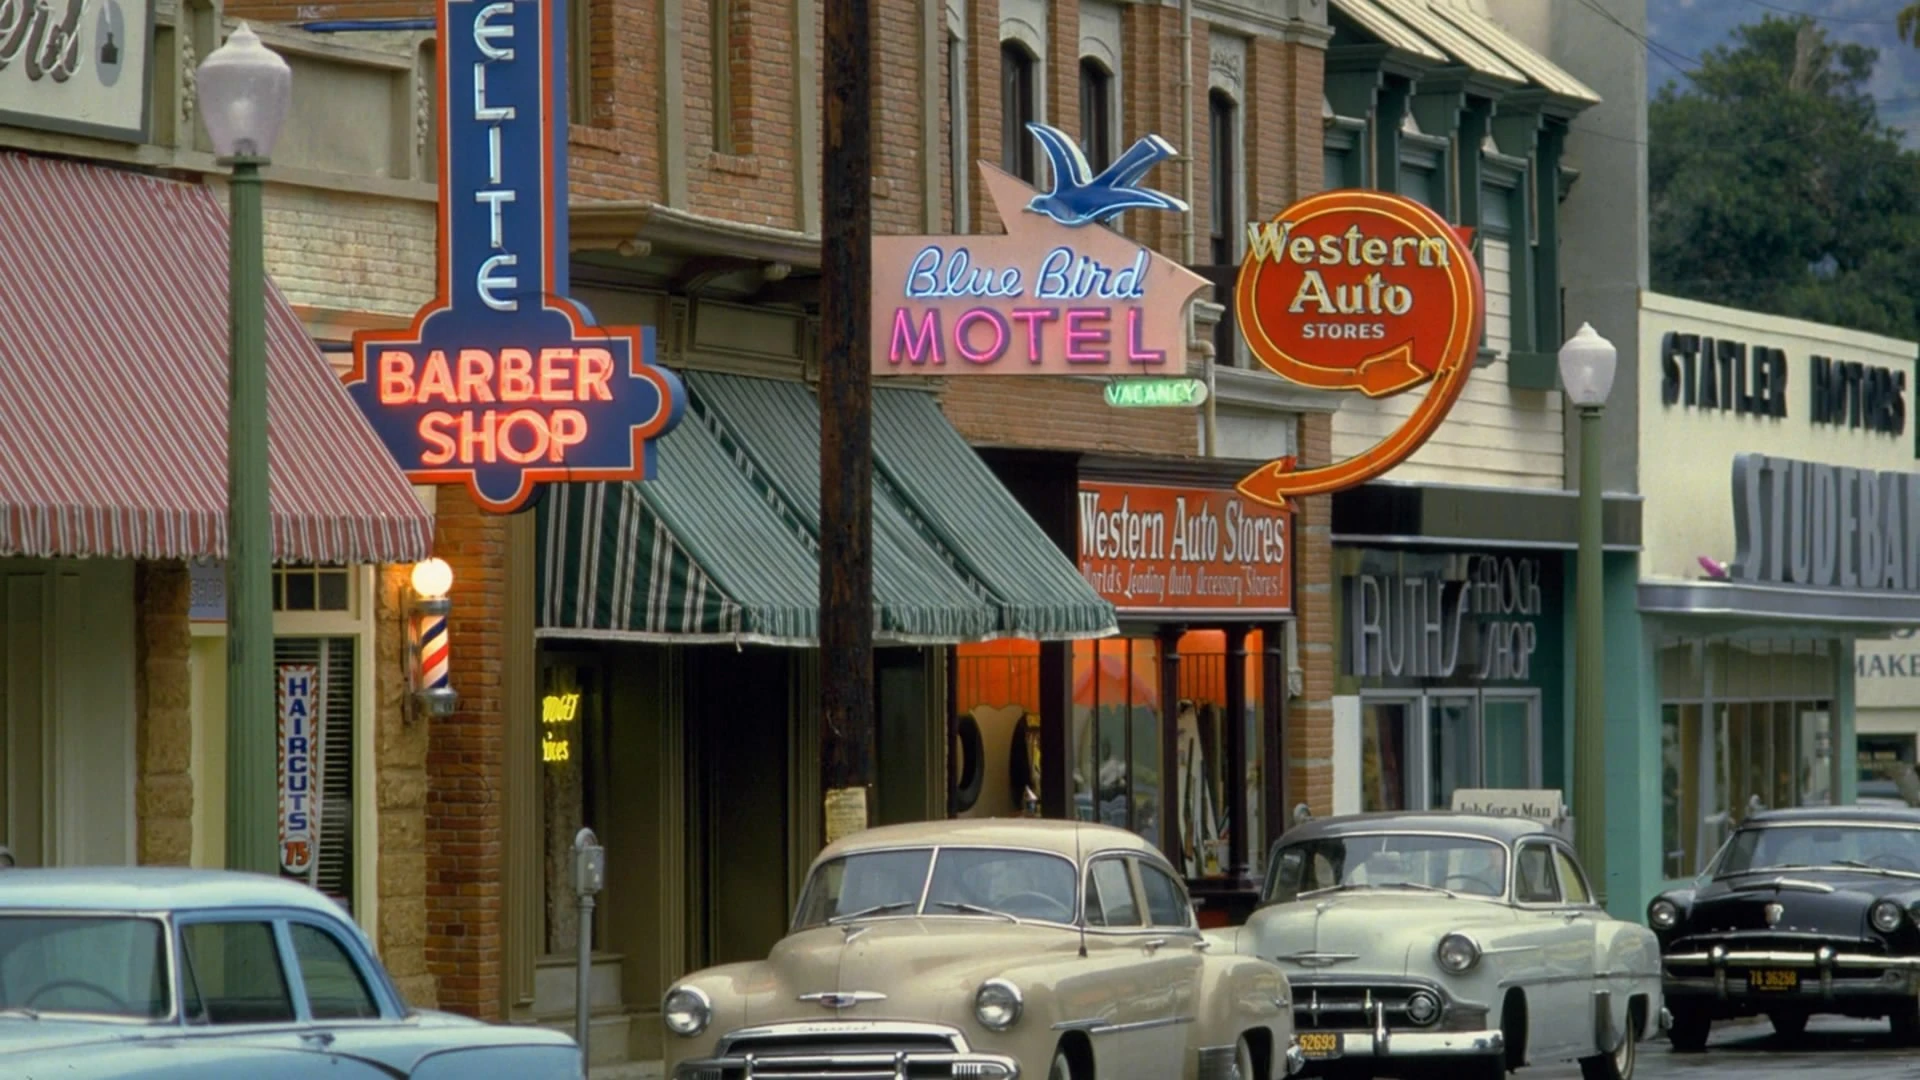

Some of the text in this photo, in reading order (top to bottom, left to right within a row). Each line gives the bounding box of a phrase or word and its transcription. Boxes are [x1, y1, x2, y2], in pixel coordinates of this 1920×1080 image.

[473, 2, 518, 311] ELITE
[904, 245, 1150, 299] Blue Bird
[1247, 221, 1449, 267] Western
[1288, 269, 1413, 316] Auto
[888, 306, 1166, 365] MOTEL
[1302, 323, 1386, 340] STORES
[378, 346, 615, 405] BARBER
[1106, 383, 1199, 405] VACANCY
[1661, 331, 1906, 437] STATLER MOTORS
[418, 407, 589, 466] SHOP
[1078, 491, 1285, 564] Western Auto Stores
[1470, 621, 1537, 680] SHOP
[288, 677, 308, 832] HAIRCUTS
[1521, 802, 1551, 818] Man
